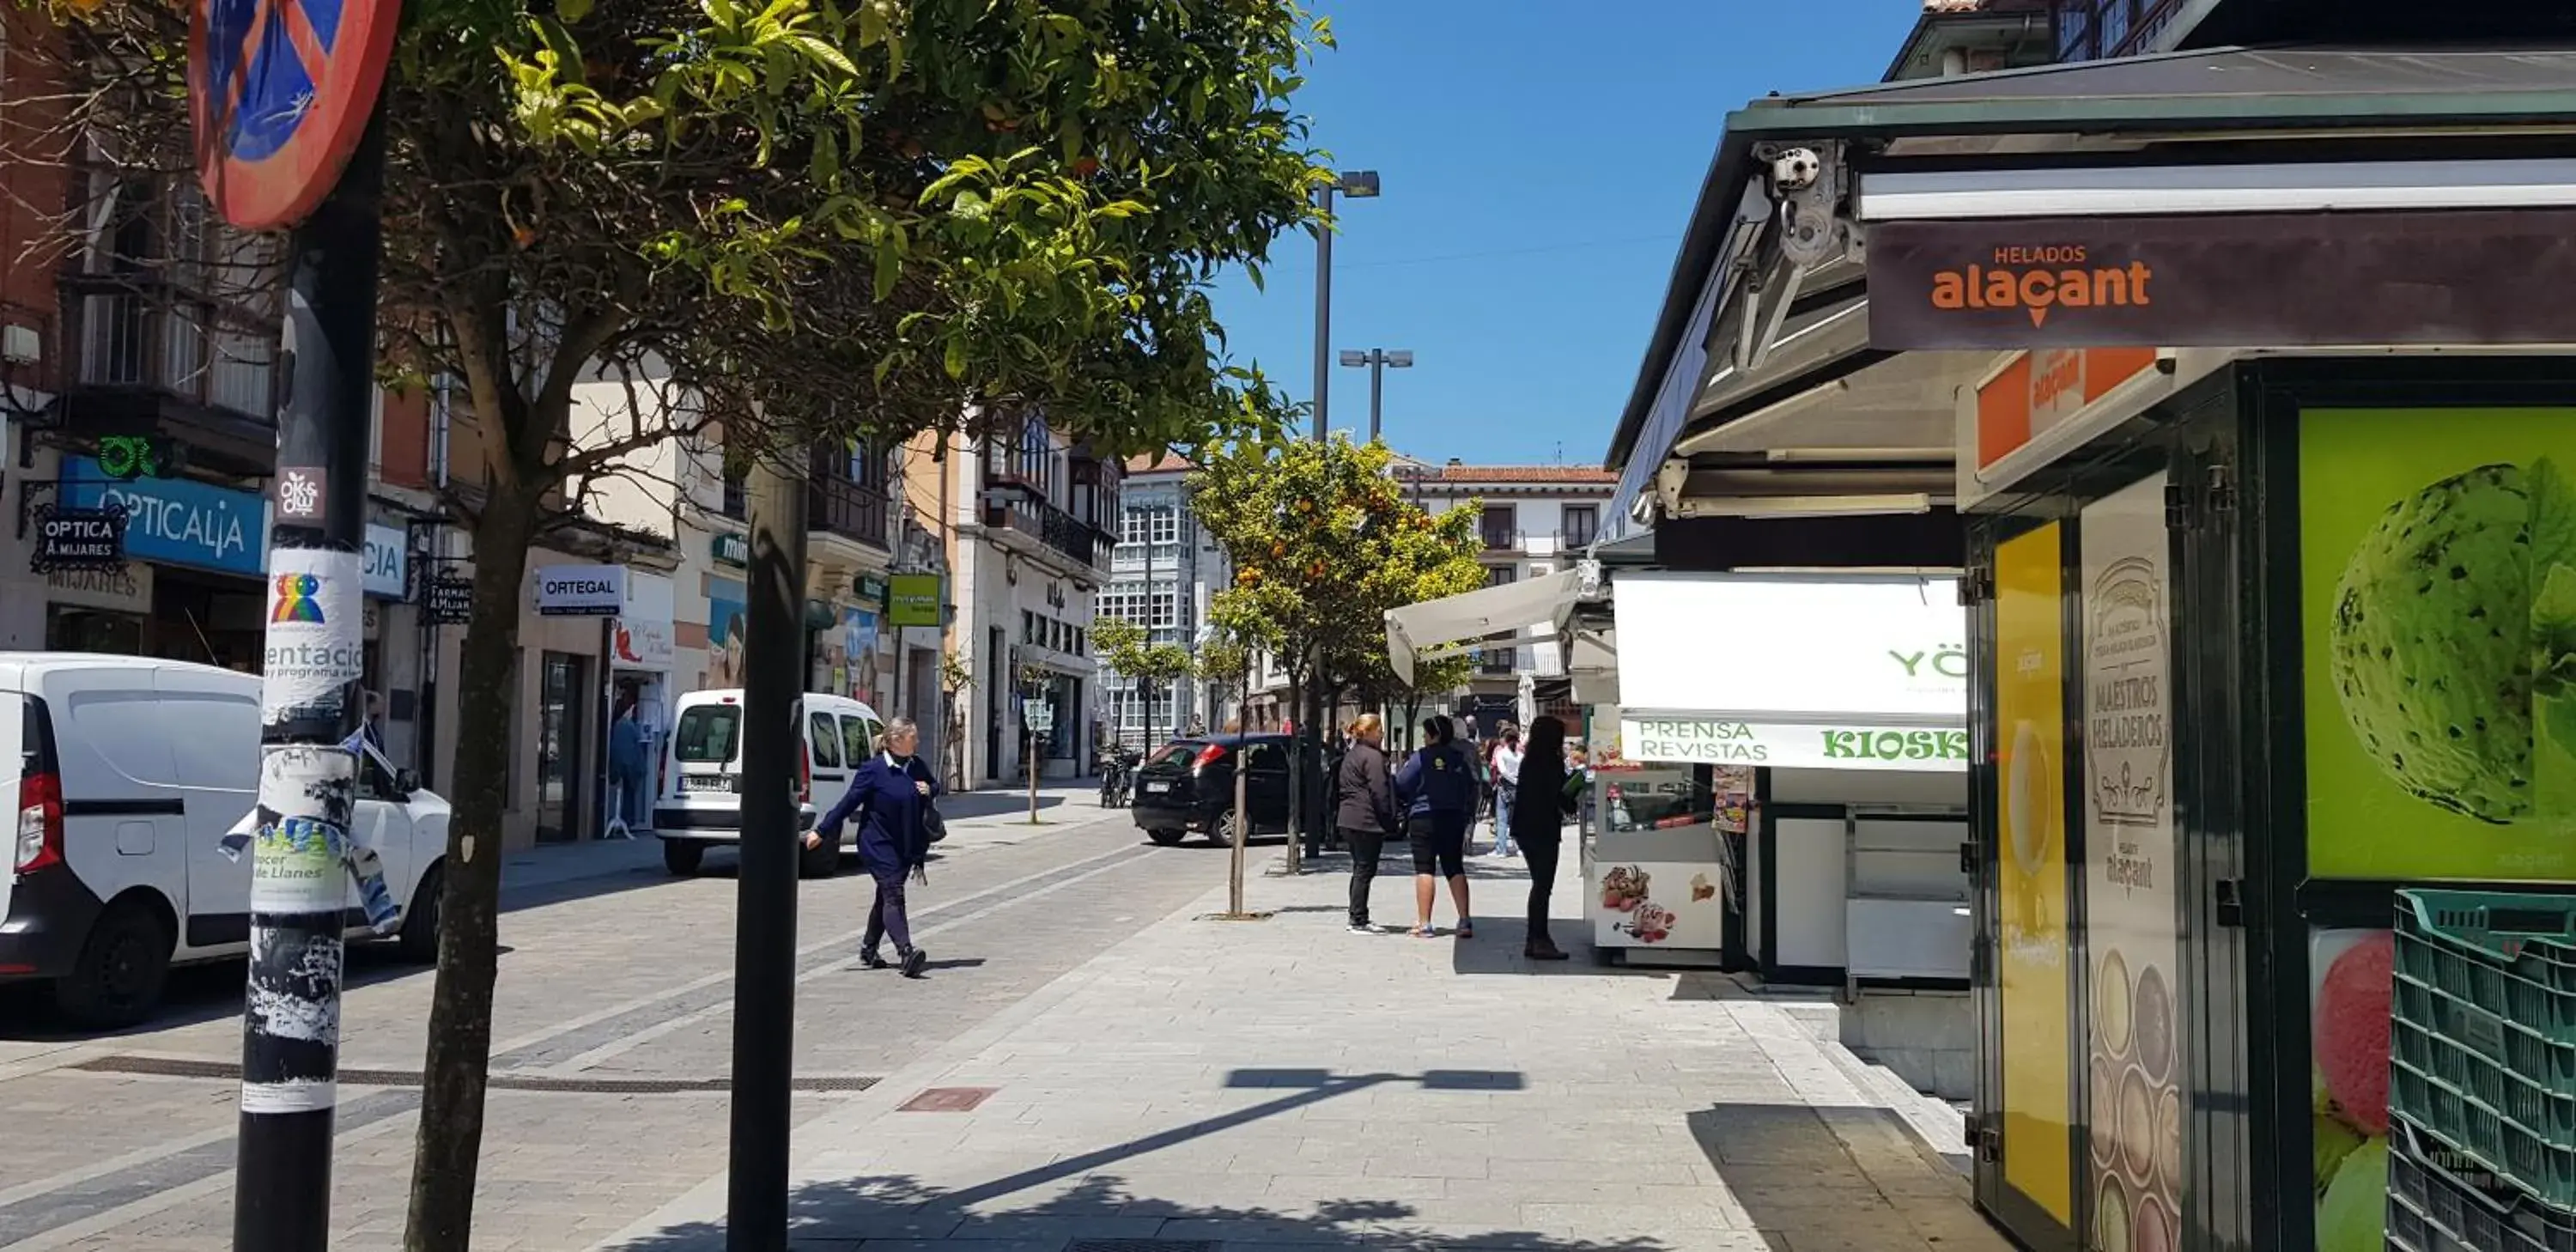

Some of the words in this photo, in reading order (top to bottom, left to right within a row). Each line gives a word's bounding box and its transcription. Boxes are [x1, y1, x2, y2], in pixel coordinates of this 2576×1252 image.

[1995, 246, 2086, 264] HELADOS
[1932, 260, 2152, 329] alaçant
[45, 520, 113, 538] OPTICA
[362, 541, 398, 580] CIA
[545, 580, 615, 594] ORTEGAL
[277, 668, 339, 678] programa
[2095, 675, 2158, 713] MAESTROS
[1639, 720, 1754, 740] PRENSA
[2092, 714, 2162, 749] HELADEROS
[1640, 739, 1768, 761] REVISTAS
[1820, 729, 1968, 761] KIOSK
[270, 866, 324, 878] Llanes
